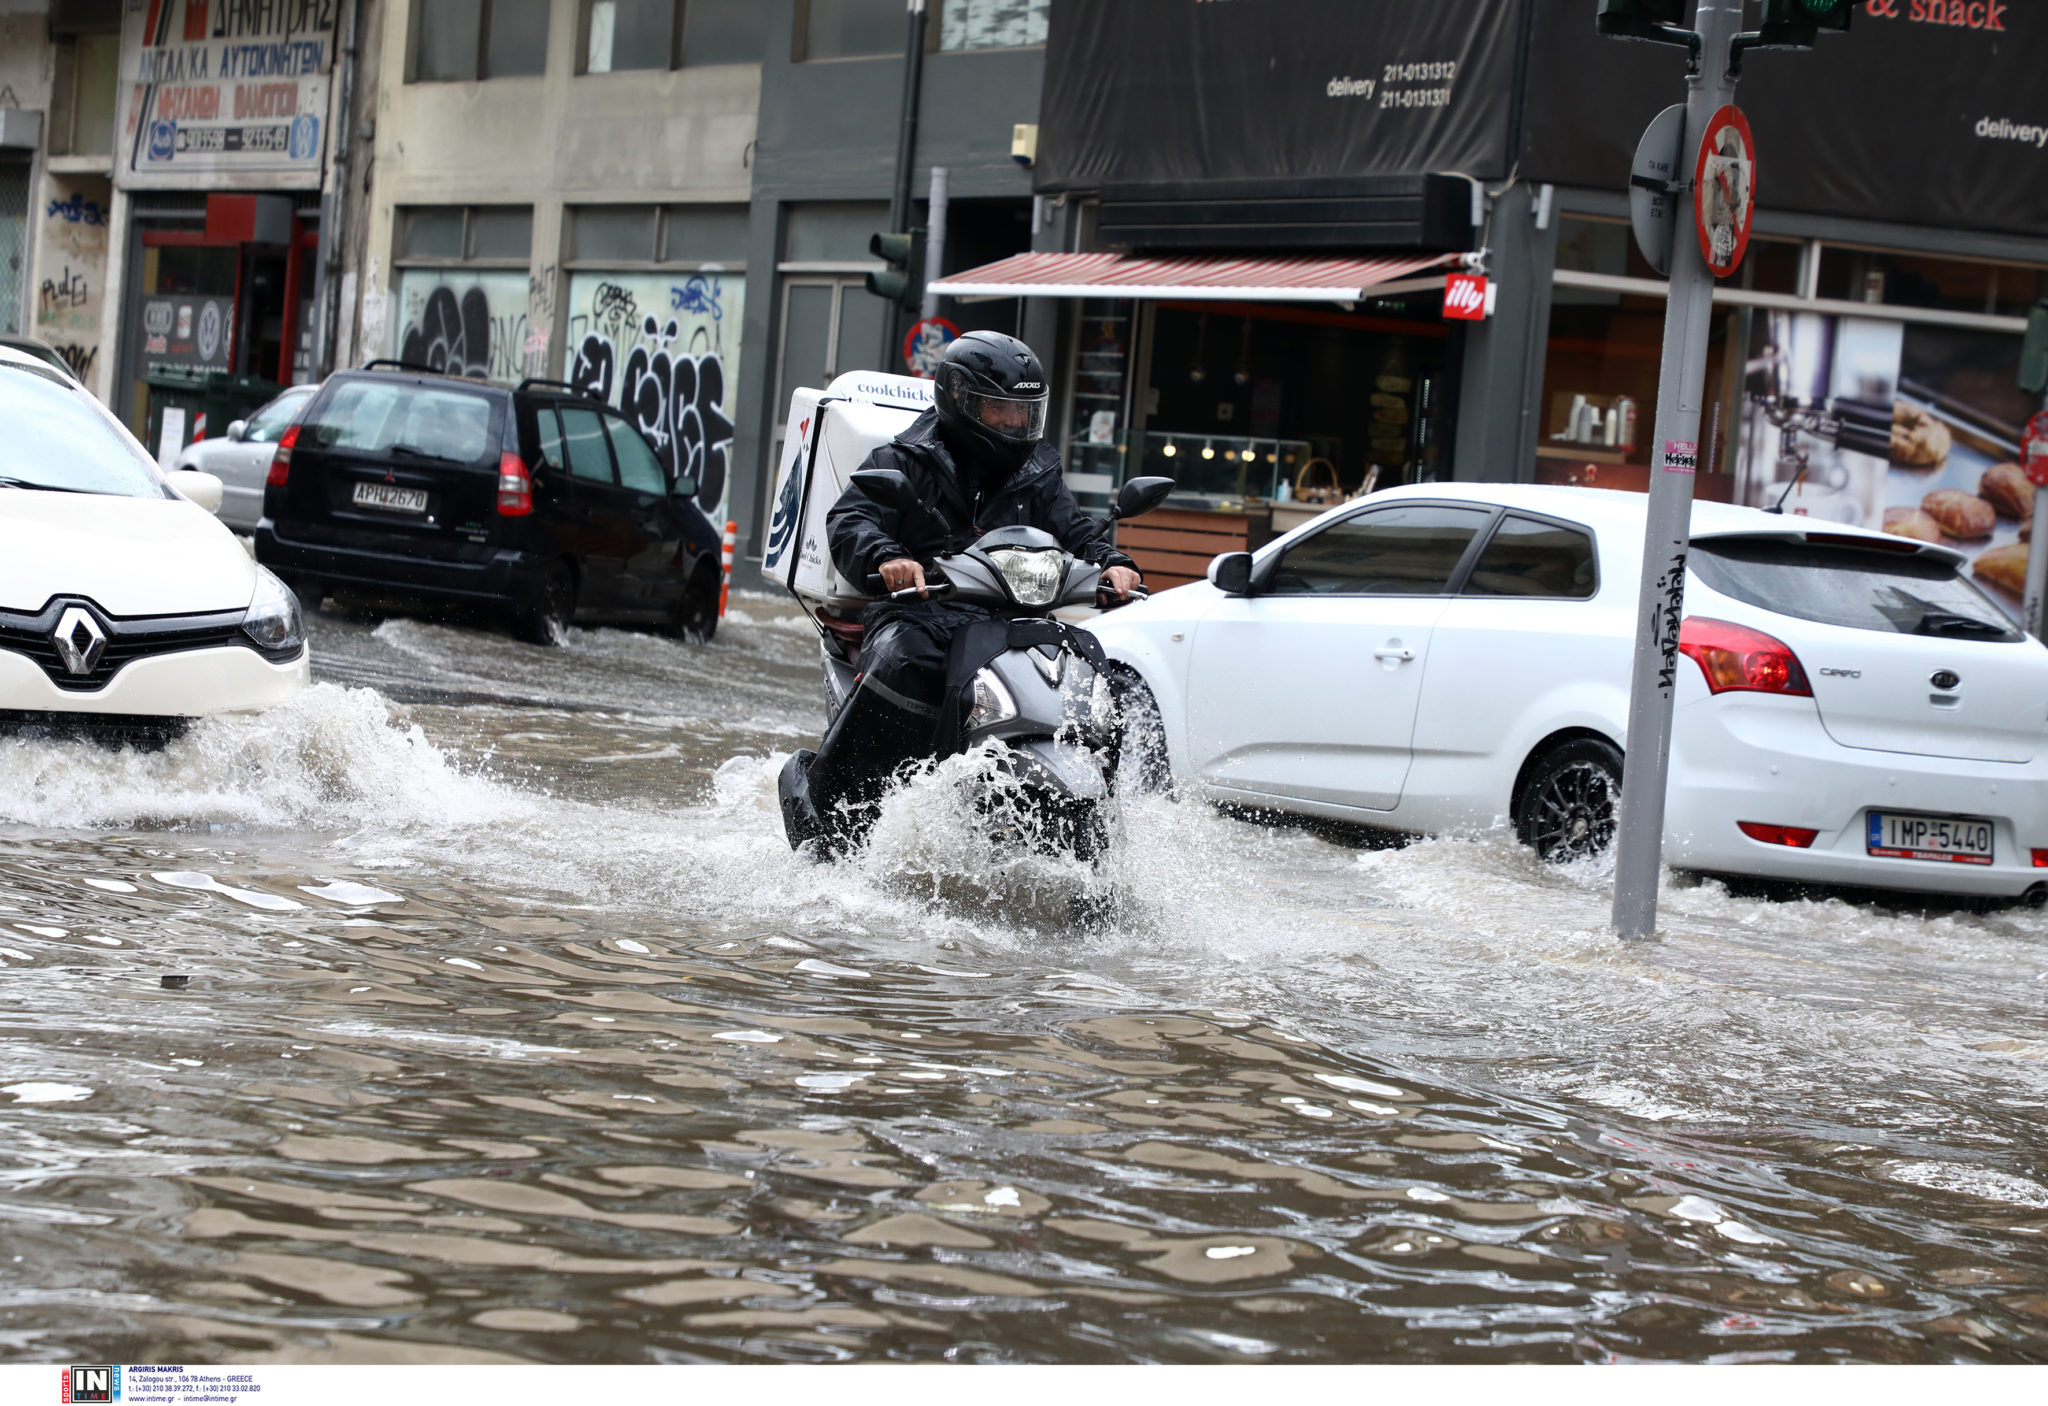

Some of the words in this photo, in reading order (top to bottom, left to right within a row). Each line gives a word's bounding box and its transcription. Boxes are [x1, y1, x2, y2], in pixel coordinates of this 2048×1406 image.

[1909, 0, 2007, 31] snack
[1327, 76, 1376, 100] delivery
[1975, 116, 2048, 148] delivery
[1446, 279, 1484, 314] illy
[857, 383, 935, 403] coolchicks
